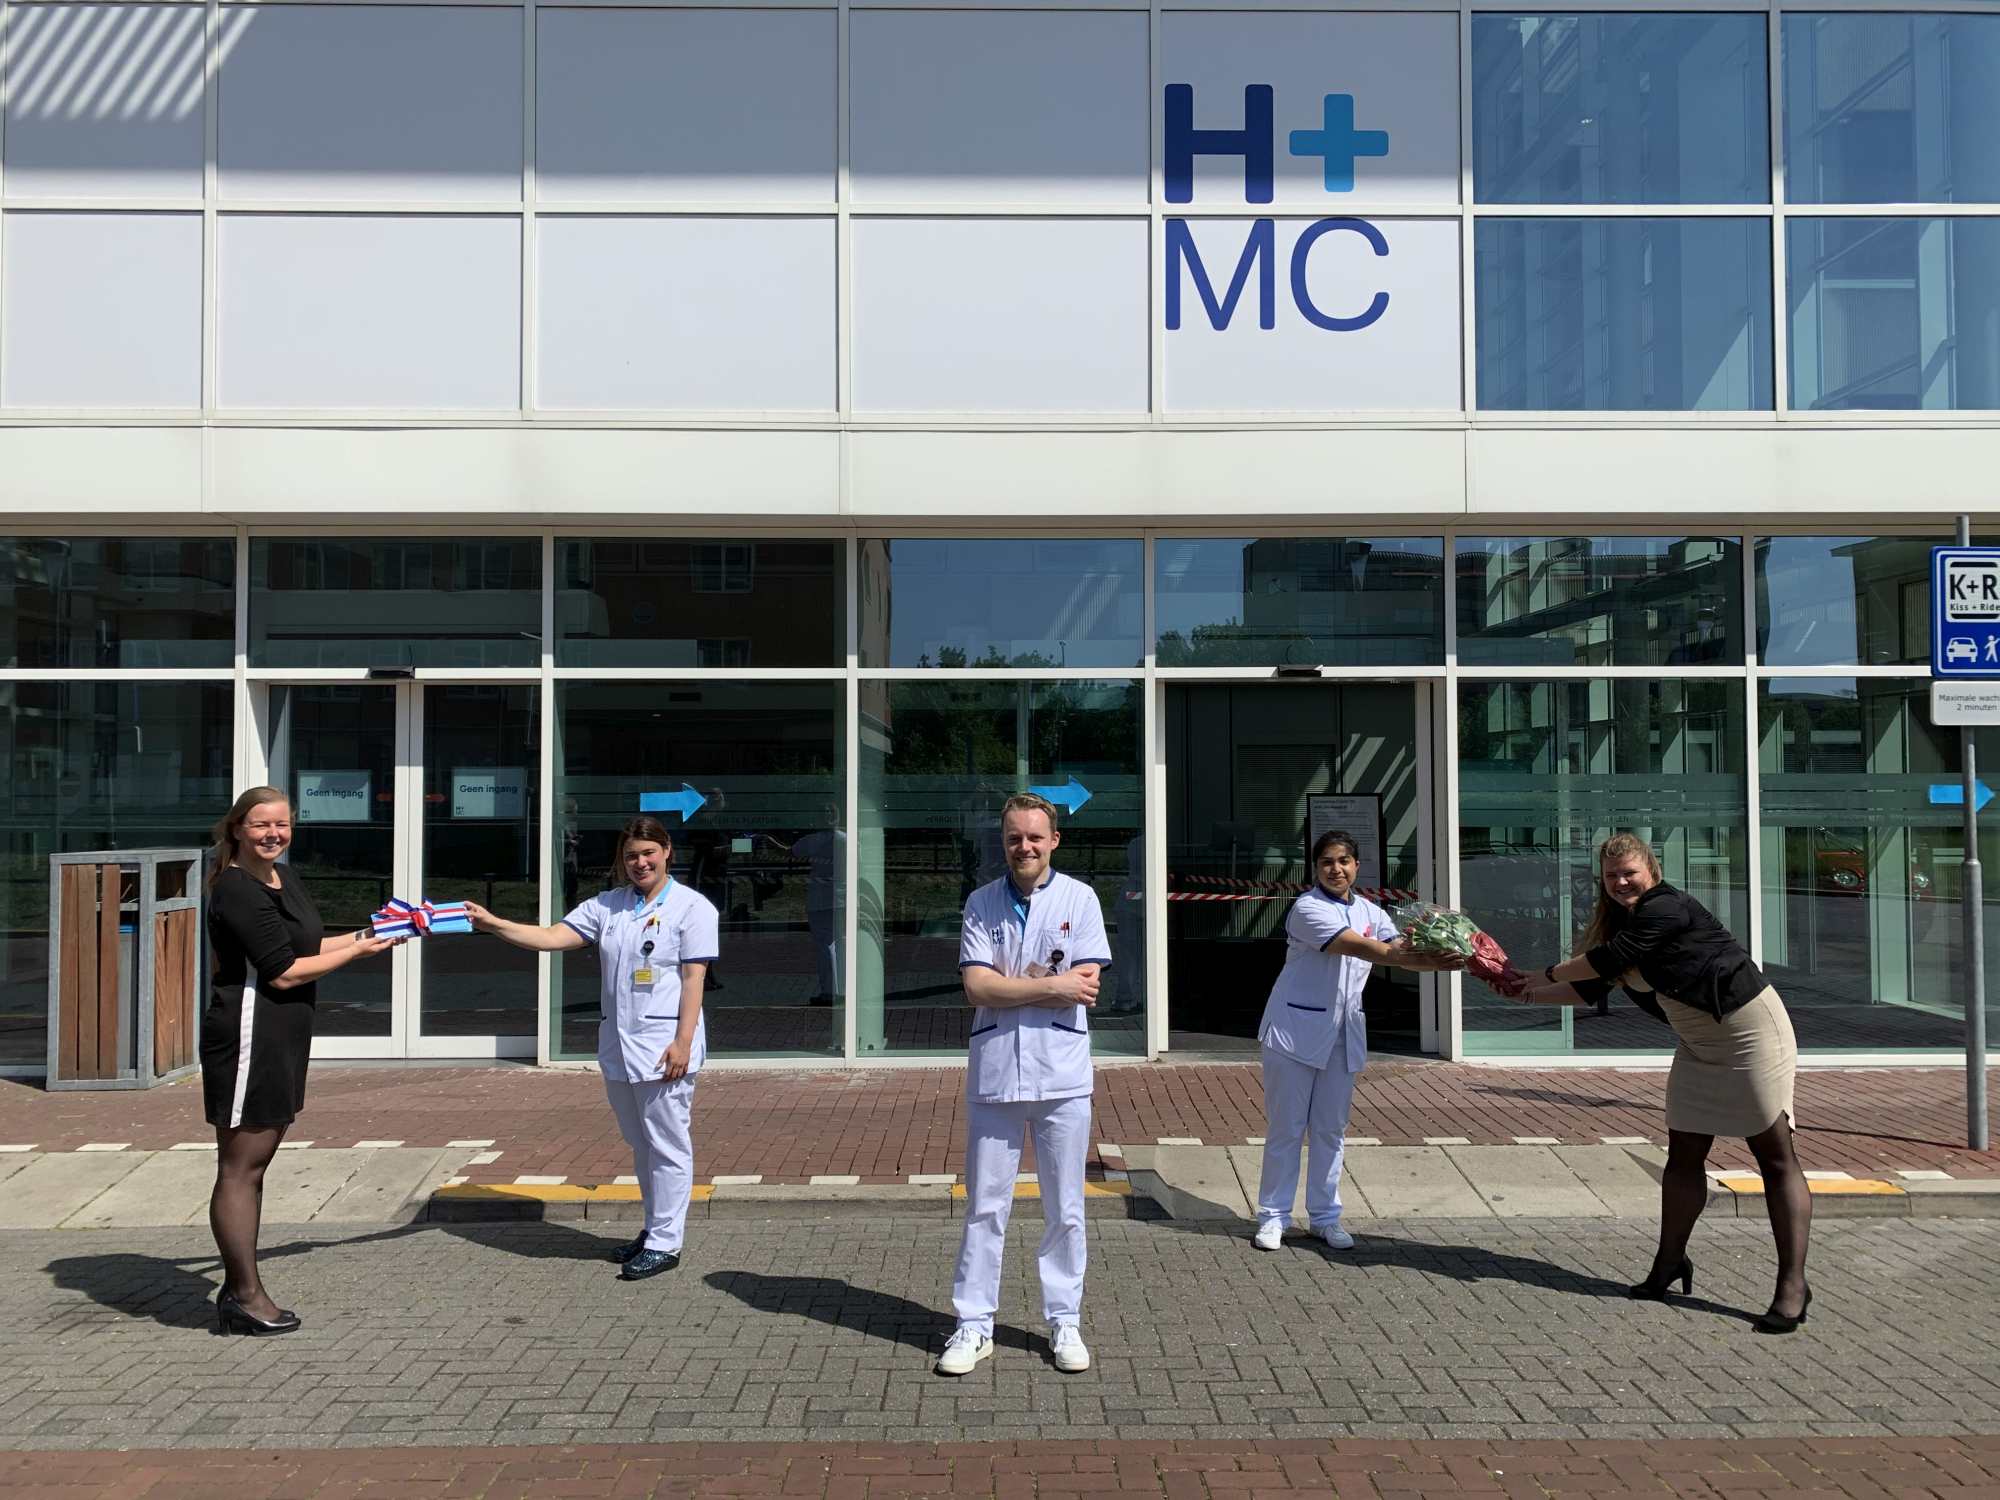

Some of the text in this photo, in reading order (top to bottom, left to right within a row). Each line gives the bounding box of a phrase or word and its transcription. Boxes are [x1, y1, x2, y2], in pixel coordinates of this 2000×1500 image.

[1165, 217, 1390, 331] MC
[1950, 574, 2000, 600] K+R
[1950, 603, 1969, 611] Kiss
[1956, 703, 1998, 711] 2 minuten
[306, 787, 364, 800] Geen ingang
[459, 784, 518, 795] Geen ingang
